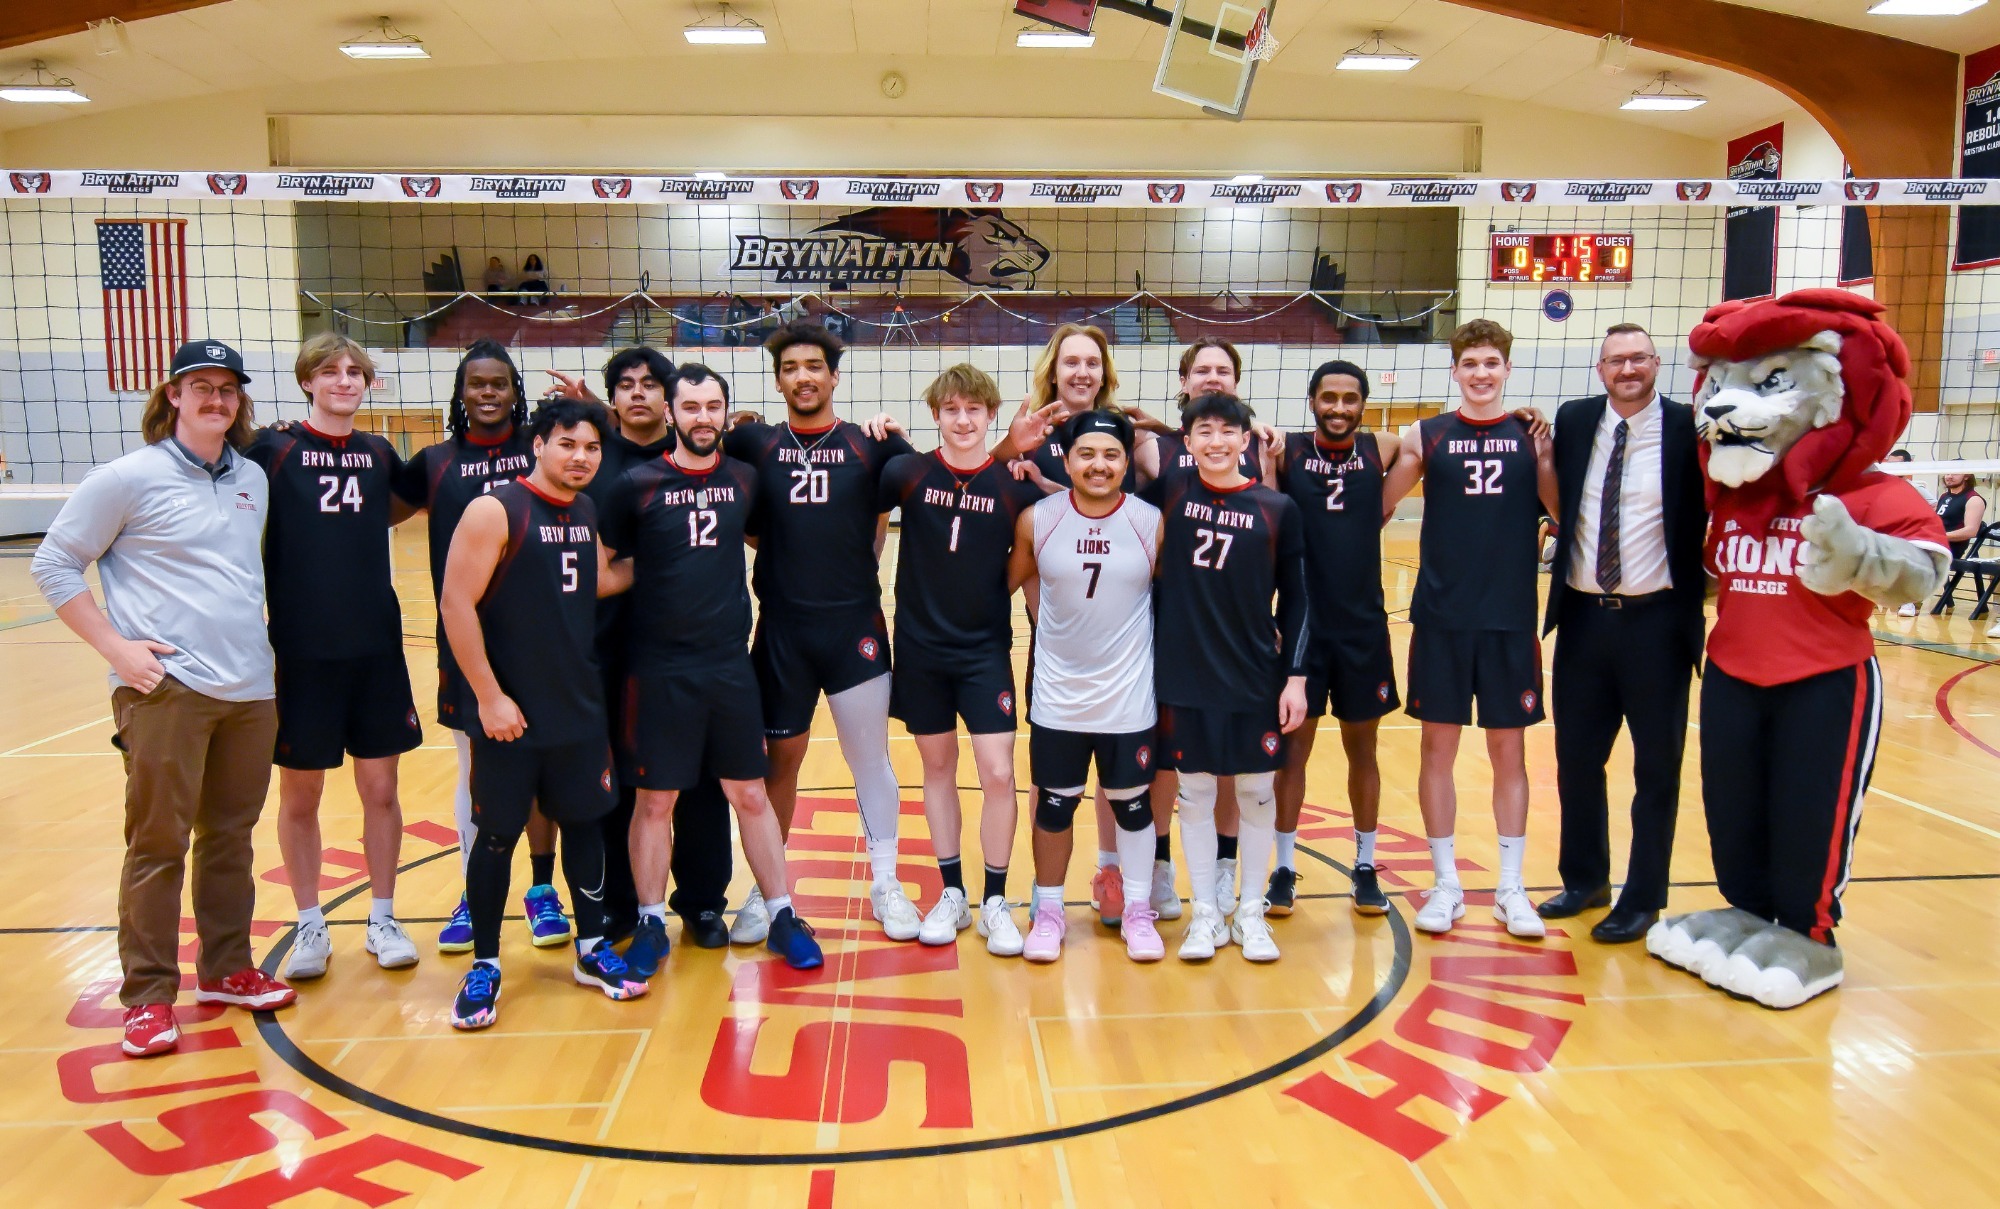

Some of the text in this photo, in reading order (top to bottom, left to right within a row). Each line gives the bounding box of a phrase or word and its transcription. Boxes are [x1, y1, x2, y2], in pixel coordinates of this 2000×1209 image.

[84, 173, 179, 187] BRYN ATHYN
[280, 176, 373, 189] BRYN ATHYN
[472, 178, 565, 191] BRYN ATHYN
[663, 180, 753, 192] BRYN ATHYN
[849, 182, 939, 195] BRYN ATHYN
[1739, 183, 1820, 194] BRYN ATHYN
[1906, 183, 1986, 193] BRYN ATHYN
[1033, 184, 1122, 196] BRYN ATHYN
[1213, 185, 1301, 196] BRYN ATHYN
[1390, 184, 1477, 195] BRYN ATHYN
[1568, 183, 1652, 195] BRYN ATHYN
[1496, 237, 1529, 246] HOME
[1555, 237, 1591, 259] 1:15
[1595, 237, 1631, 247] GUEST
[739, 236, 953, 268] BRYN ATHYN
[1514, 247, 1528, 268] 0
[1614, 247, 1628, 268] 0
[781, 270, 897, 281] ATHLETICS
[1533, 263, 1545, 281] 2
[1580, 263, 1591, 281] 2
[1448, 439, 1518, 454] BRYN ATHYN
[302, 451, 373, 468] BRYN ATHYN
[778, 448, 844, 463] BRYN ATHYN
[1179, 454, 1199, 468] BR
[461, 454, 529, 477] BRYN ATHYN
[1305, 458, 1332, 475] BRYN
[1464, 459, 1503, 495] 32
[319, 475, 363, 513] 24
[790, 470, 829, 503] 20
[1326, 478, 1344, 510] 2
[665, 487, 735, 505] BRYN THYN
[924, 488, 995, 513] BRYN ATHYN
[1185, 501, 1254, 529] BRYN ATHYN
[539, 526, 591, 543] BRYN ATHYN
[688, 510, 718, 546] 12
[950, 516, 961, 551] 1
[1076, 539, 1110, 555] LIONS
[1193, 528, 1233, 570] 27
[561, 551, 578, 592] 5
[1083, 562, 1102, 599] 7
[1729, 579, 1788, 595] OLLEGE
